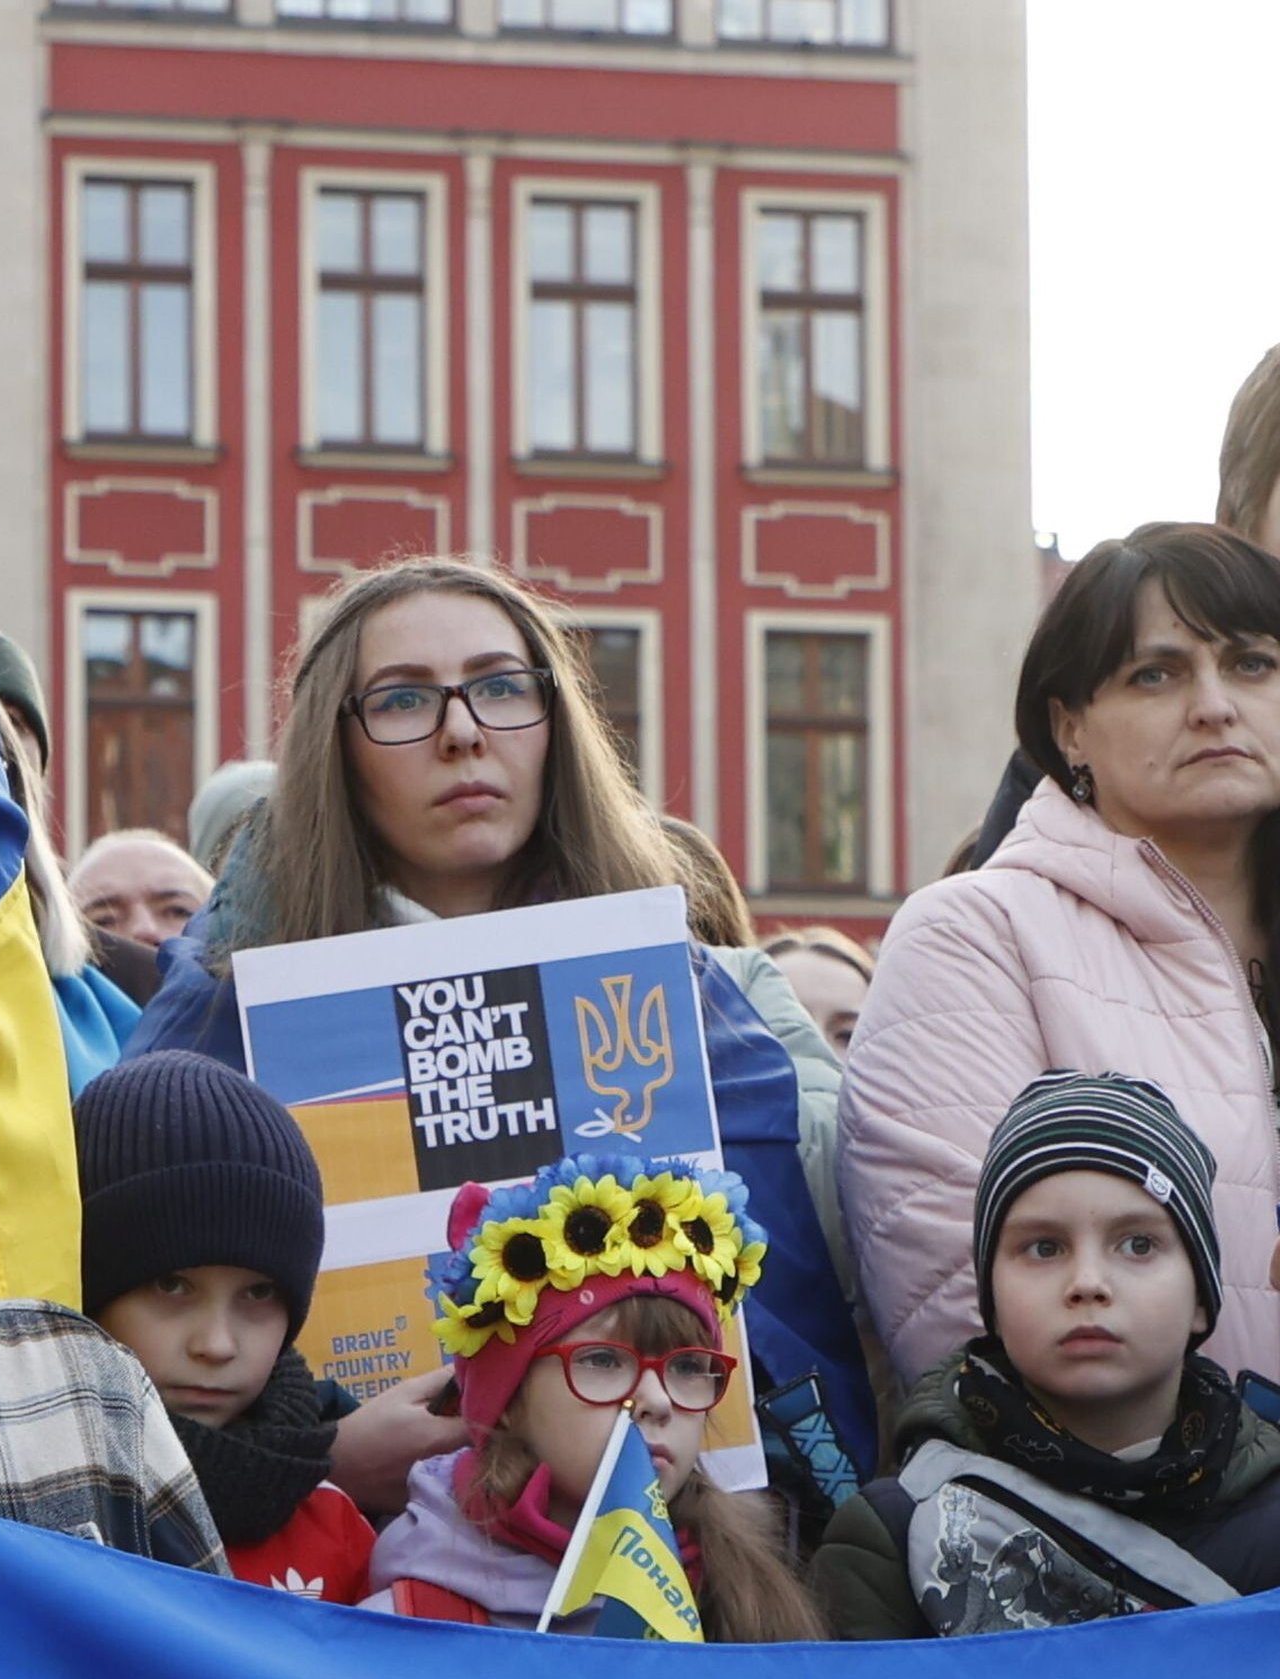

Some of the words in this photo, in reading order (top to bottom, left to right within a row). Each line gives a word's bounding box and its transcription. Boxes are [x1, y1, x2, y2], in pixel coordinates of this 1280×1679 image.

[397, 975, 485, 1017] YOU
[403, 1002, 528, 1050] CAN'T
[408, 1037, 533, 1084] BOMB
[411, 1074, 495, 1115] THE
[415, 1098, 556, 1148] TRUTH
[323, 1351, 410, 1380] COUNTRY
